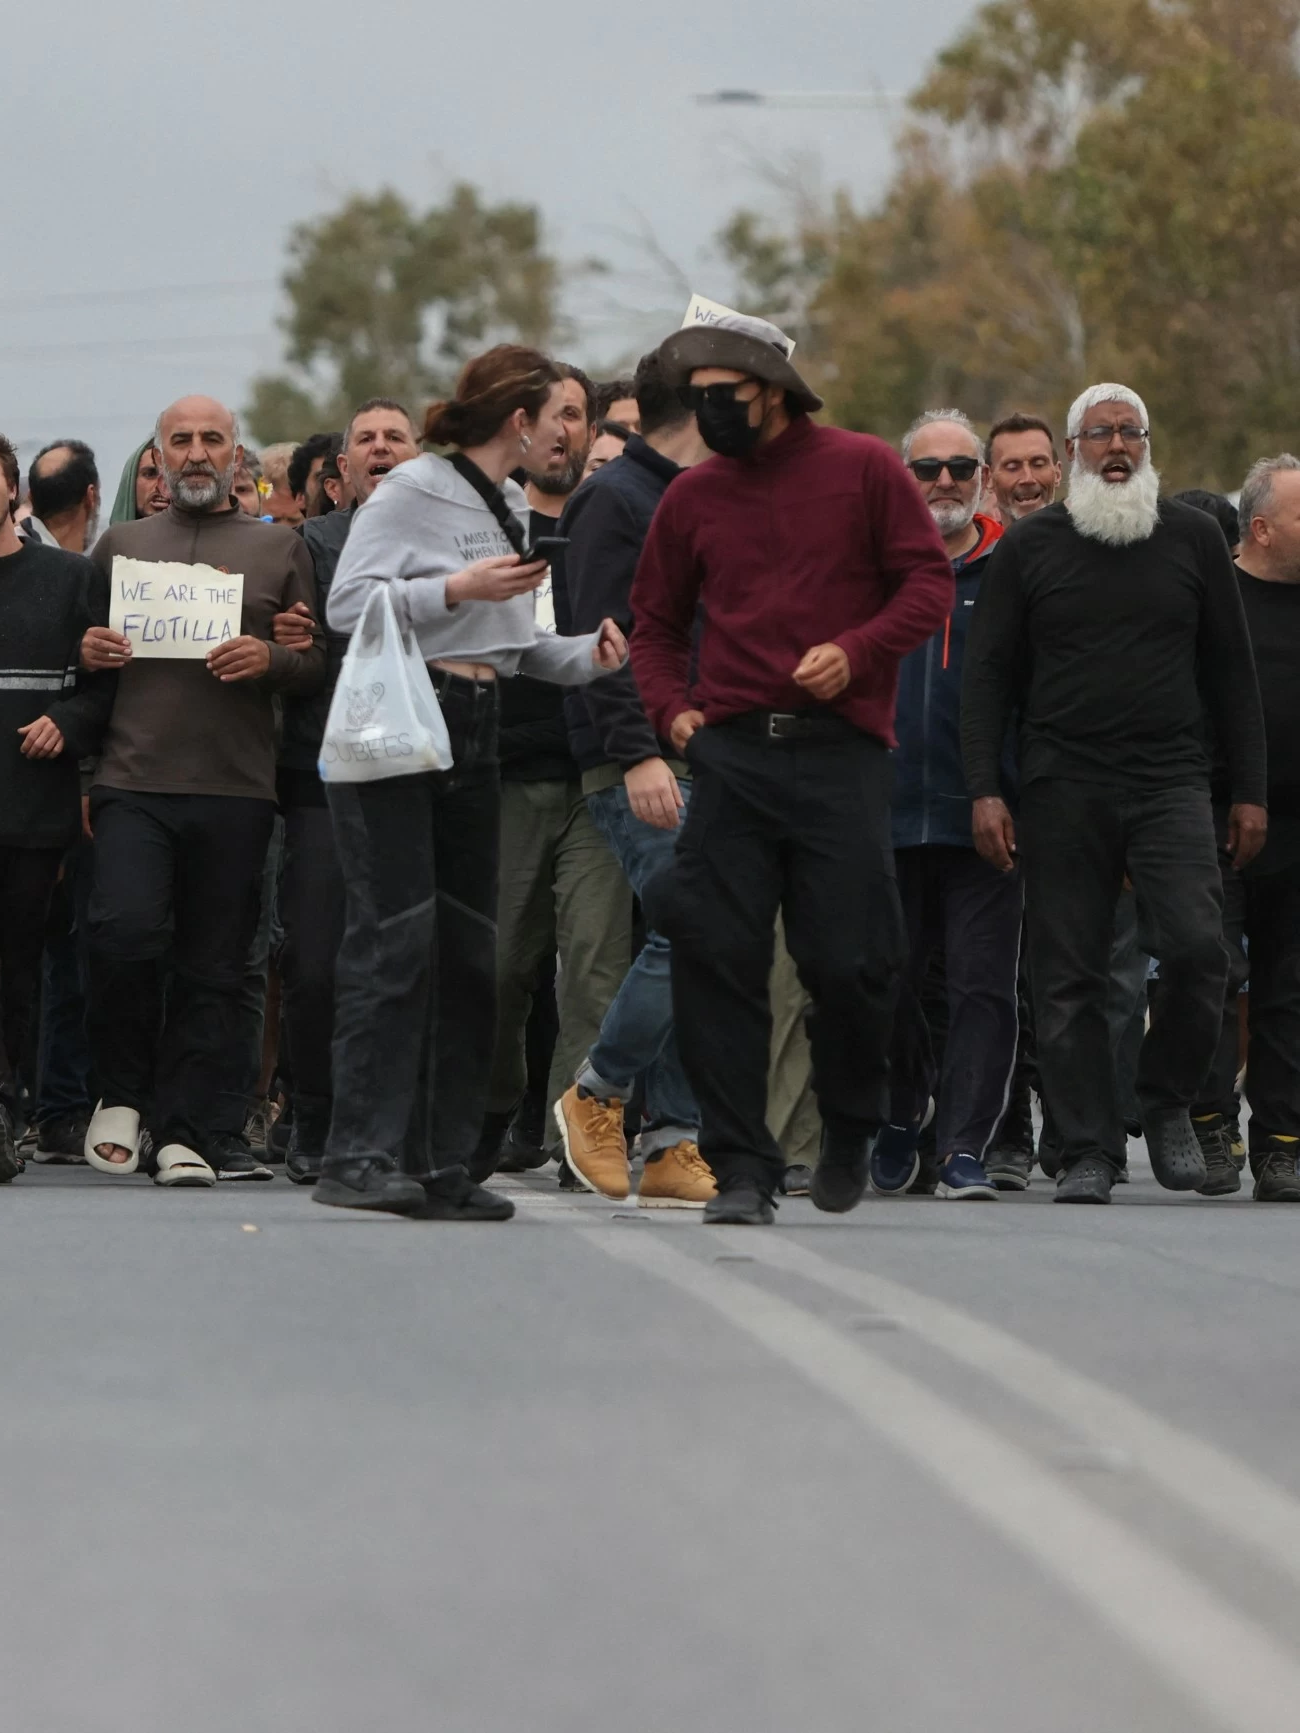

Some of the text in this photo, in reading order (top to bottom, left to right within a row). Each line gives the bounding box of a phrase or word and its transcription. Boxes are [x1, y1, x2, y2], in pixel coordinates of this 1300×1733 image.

[453, 530, 508, 548] I MISS YO
[459, 546, 496, 561] WHEN
[121, 580, 237, 605] WE ARE THE
[123, 613, 232, 643] FLOTILLA
